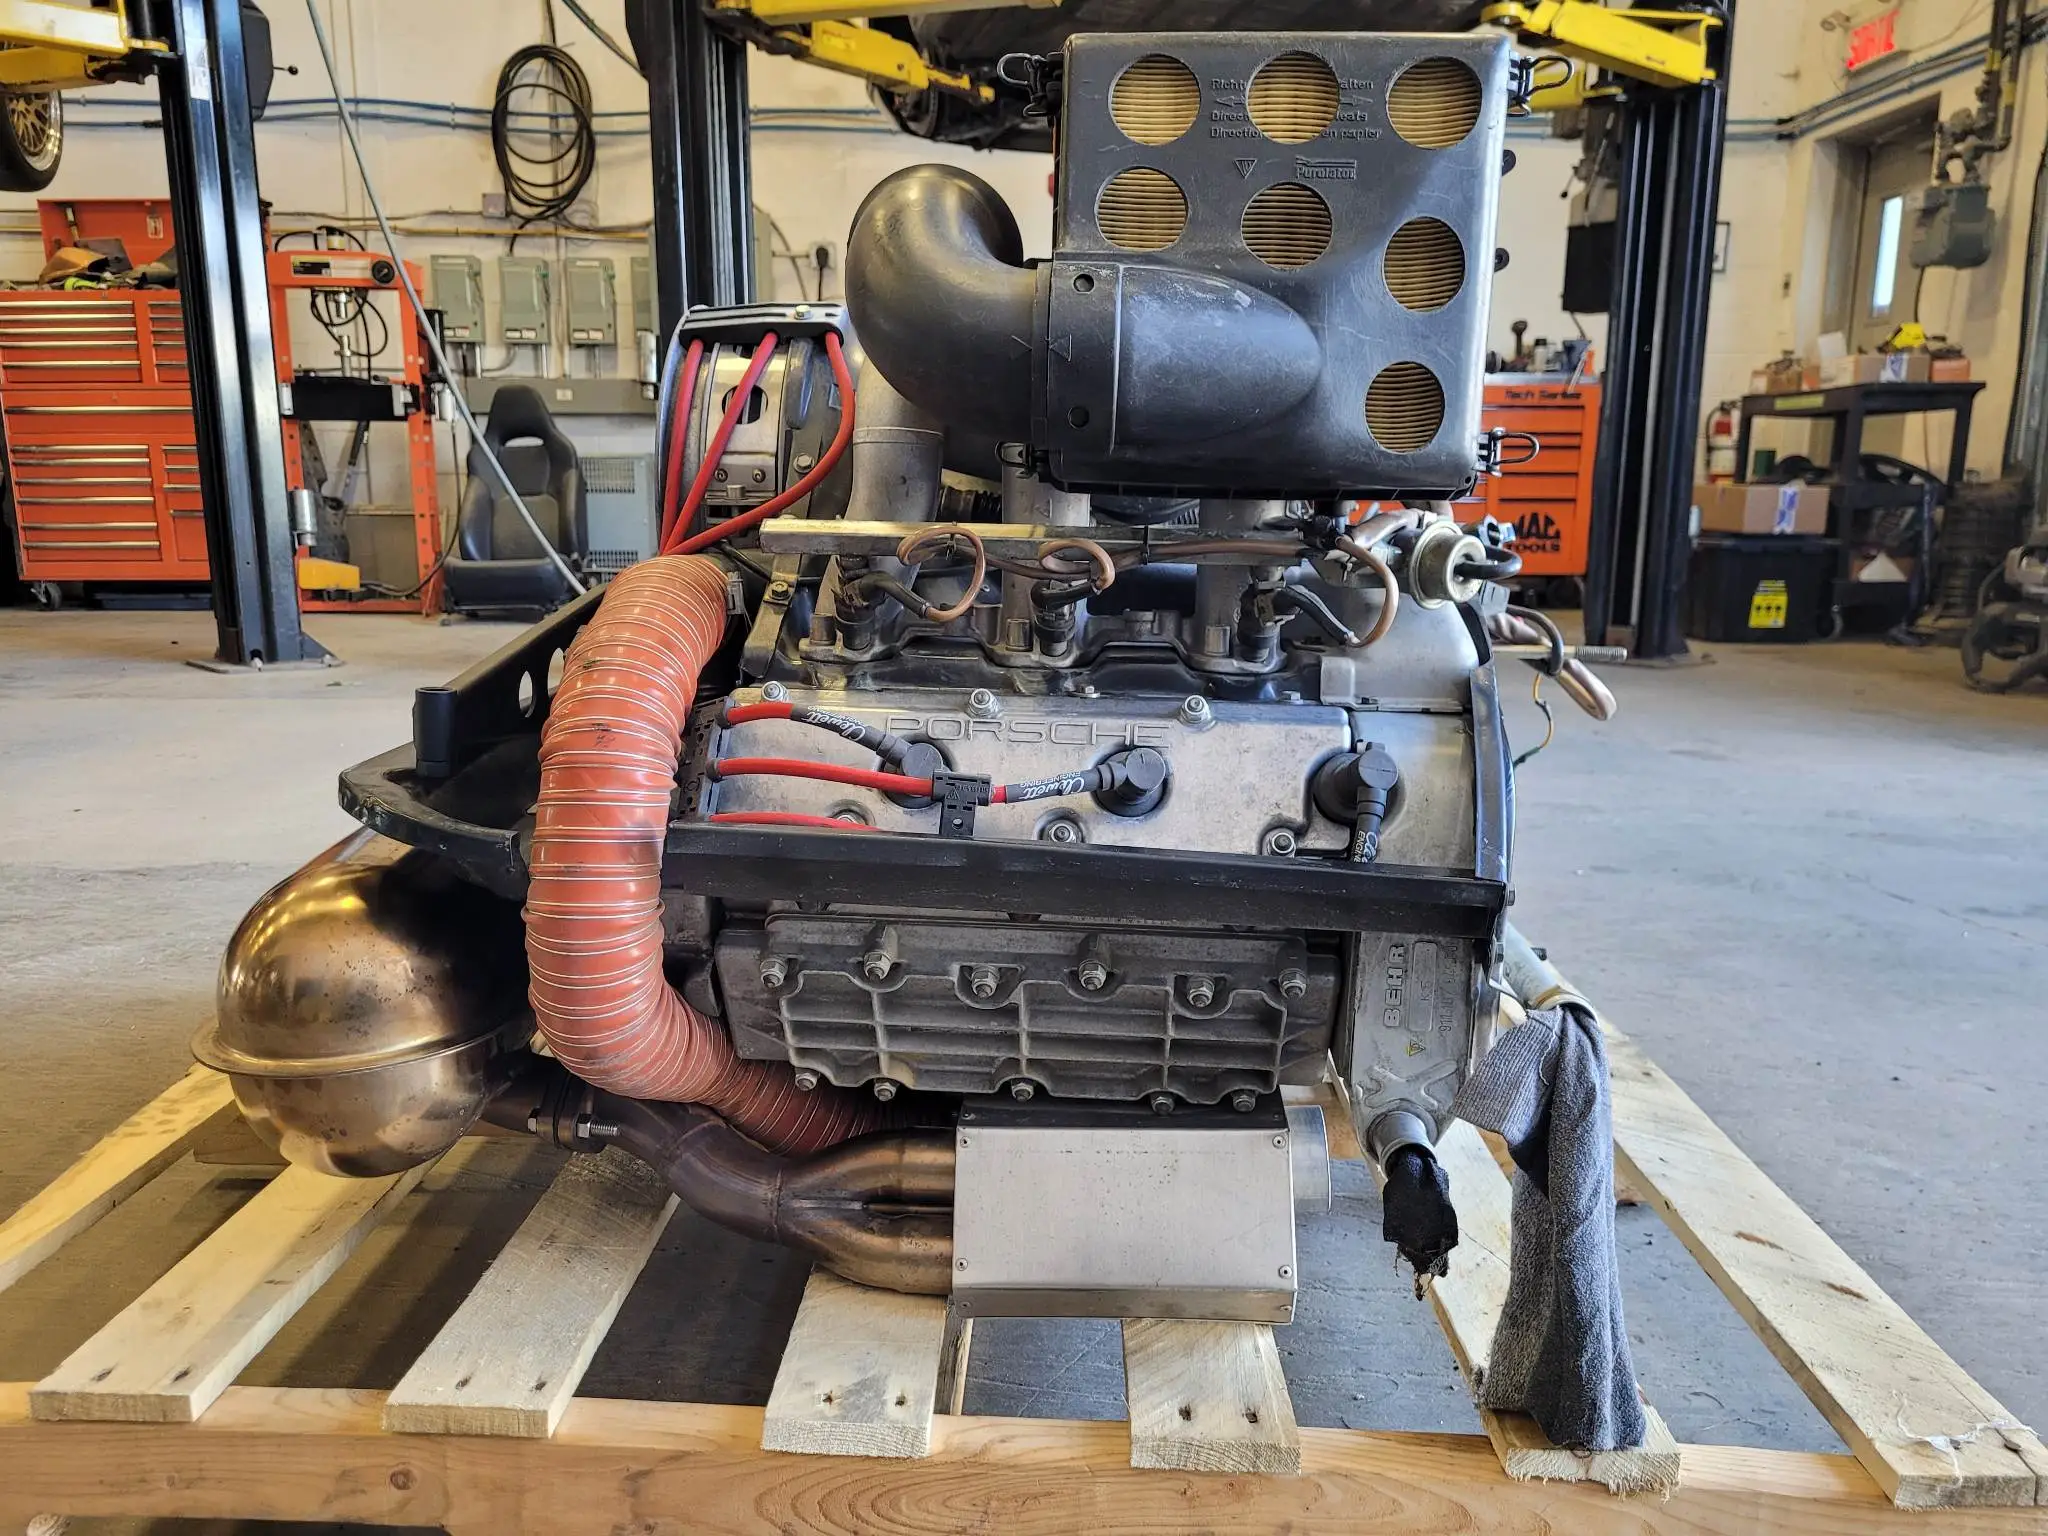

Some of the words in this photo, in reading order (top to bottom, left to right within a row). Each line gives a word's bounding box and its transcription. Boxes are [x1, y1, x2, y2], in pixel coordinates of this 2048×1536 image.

[801, 711, 866, 741] Clewett
[887, 715, 1172, 749] PORSCHE
[1018, 777, 1085, 800] Clewett
[1383, 944, 1406, 1028] BEHR
